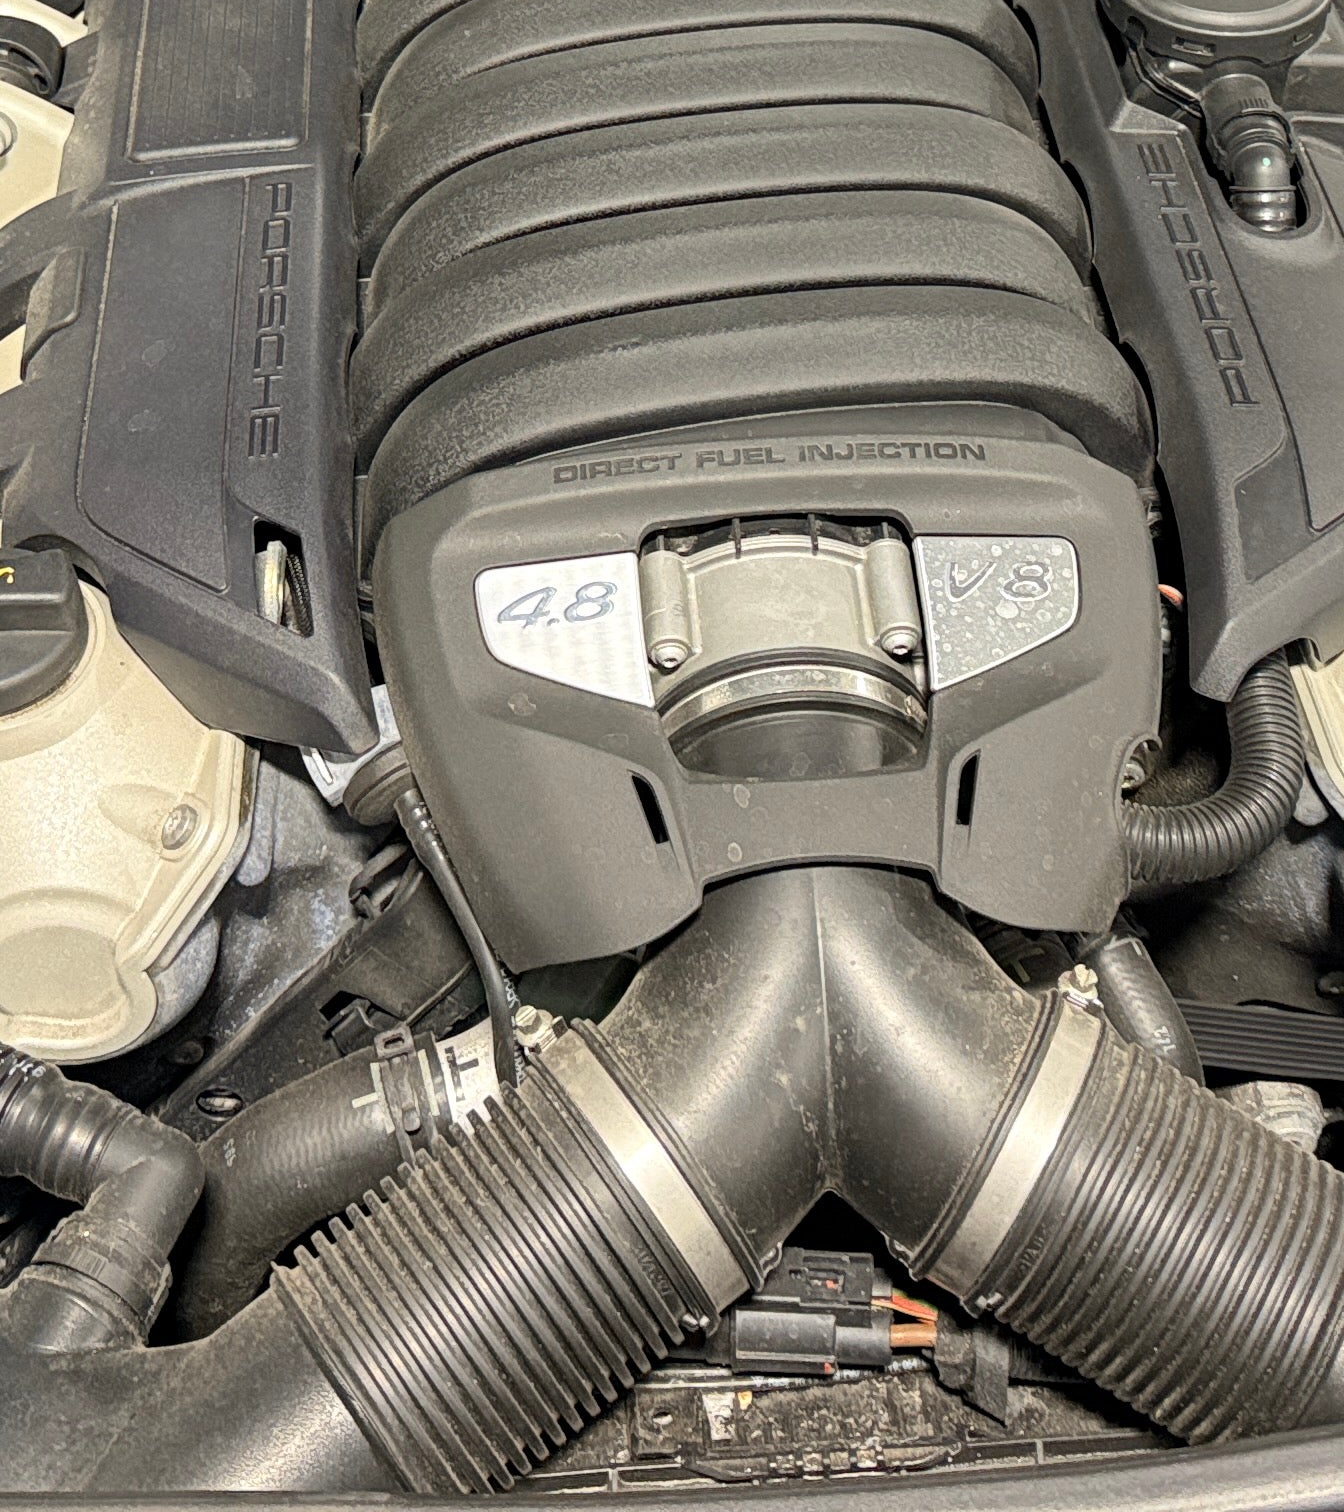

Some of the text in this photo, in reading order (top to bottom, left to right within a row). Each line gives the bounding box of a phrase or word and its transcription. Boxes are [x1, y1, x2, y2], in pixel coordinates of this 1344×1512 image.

[247, 181, 293, 459] PORSCHE
[1136, 142, 1261, 408] PORSCHE
[553, 440, 986, 485] DIRECT FUEL INJECTION
[496, 580, 618, 630] 4.8
